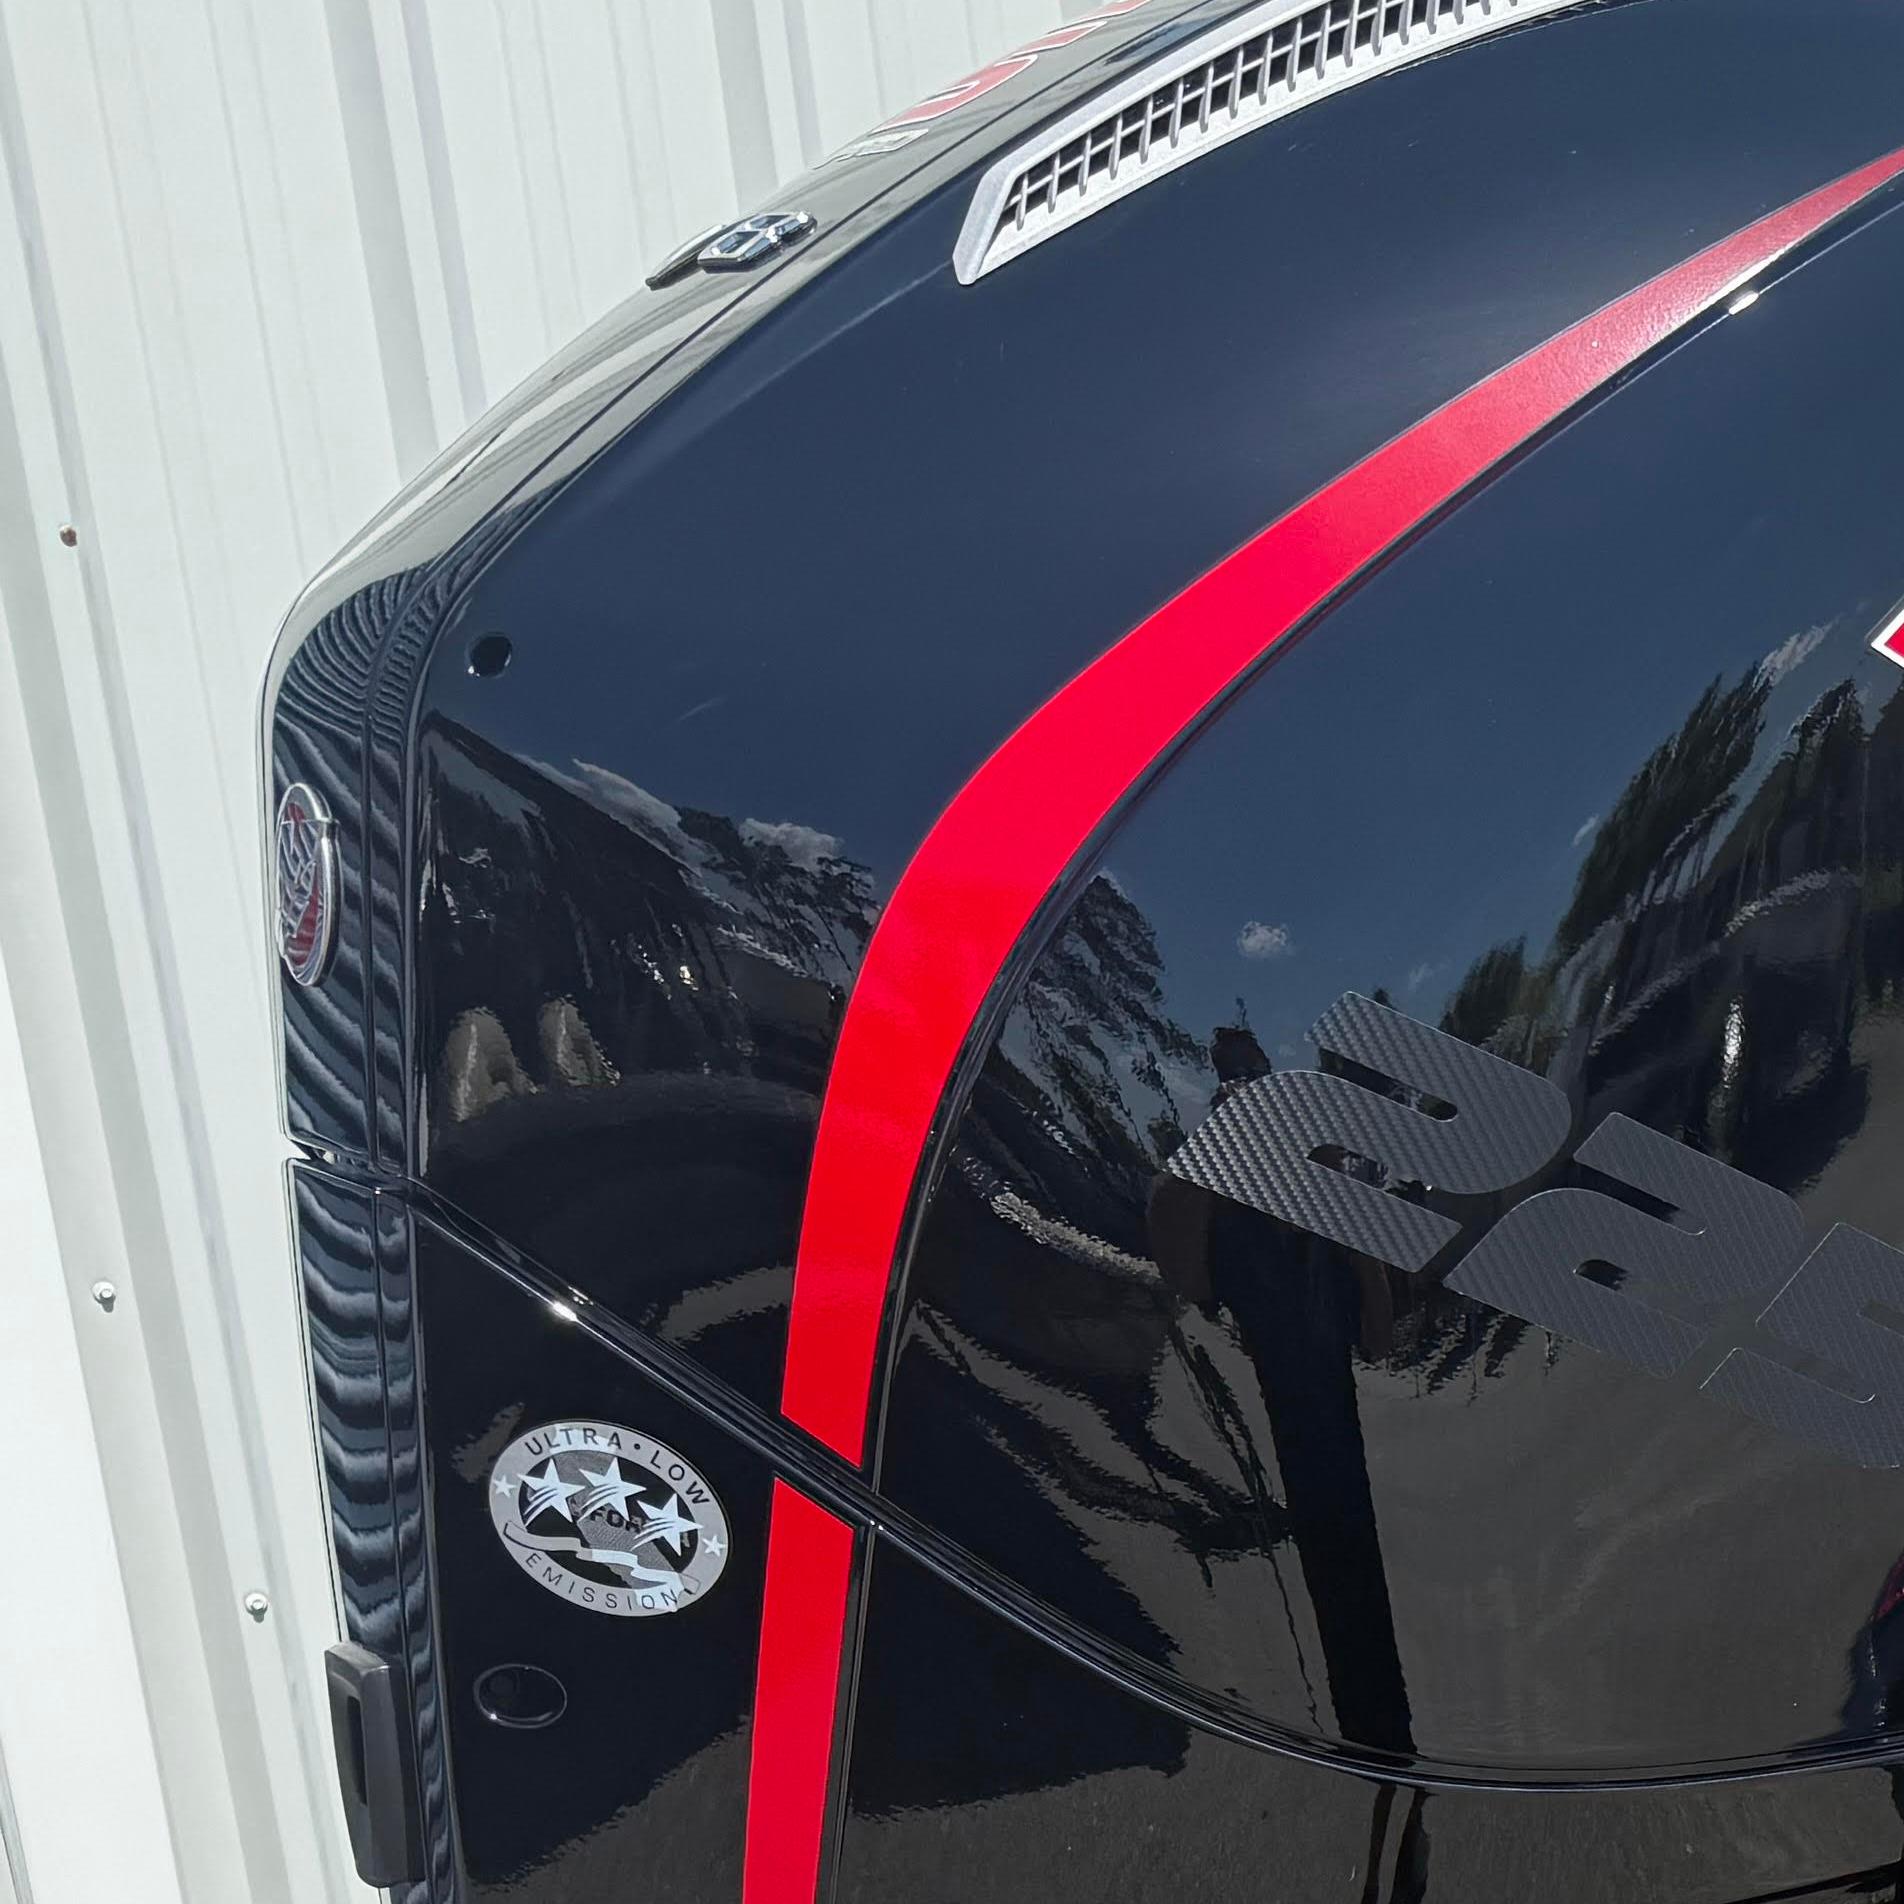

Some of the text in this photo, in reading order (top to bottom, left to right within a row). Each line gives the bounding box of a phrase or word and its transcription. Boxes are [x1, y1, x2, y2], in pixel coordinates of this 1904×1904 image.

[525, 1427, 710, 1505] ULTRA LOW
[525, 1552, 679, 1610] EMISSION
